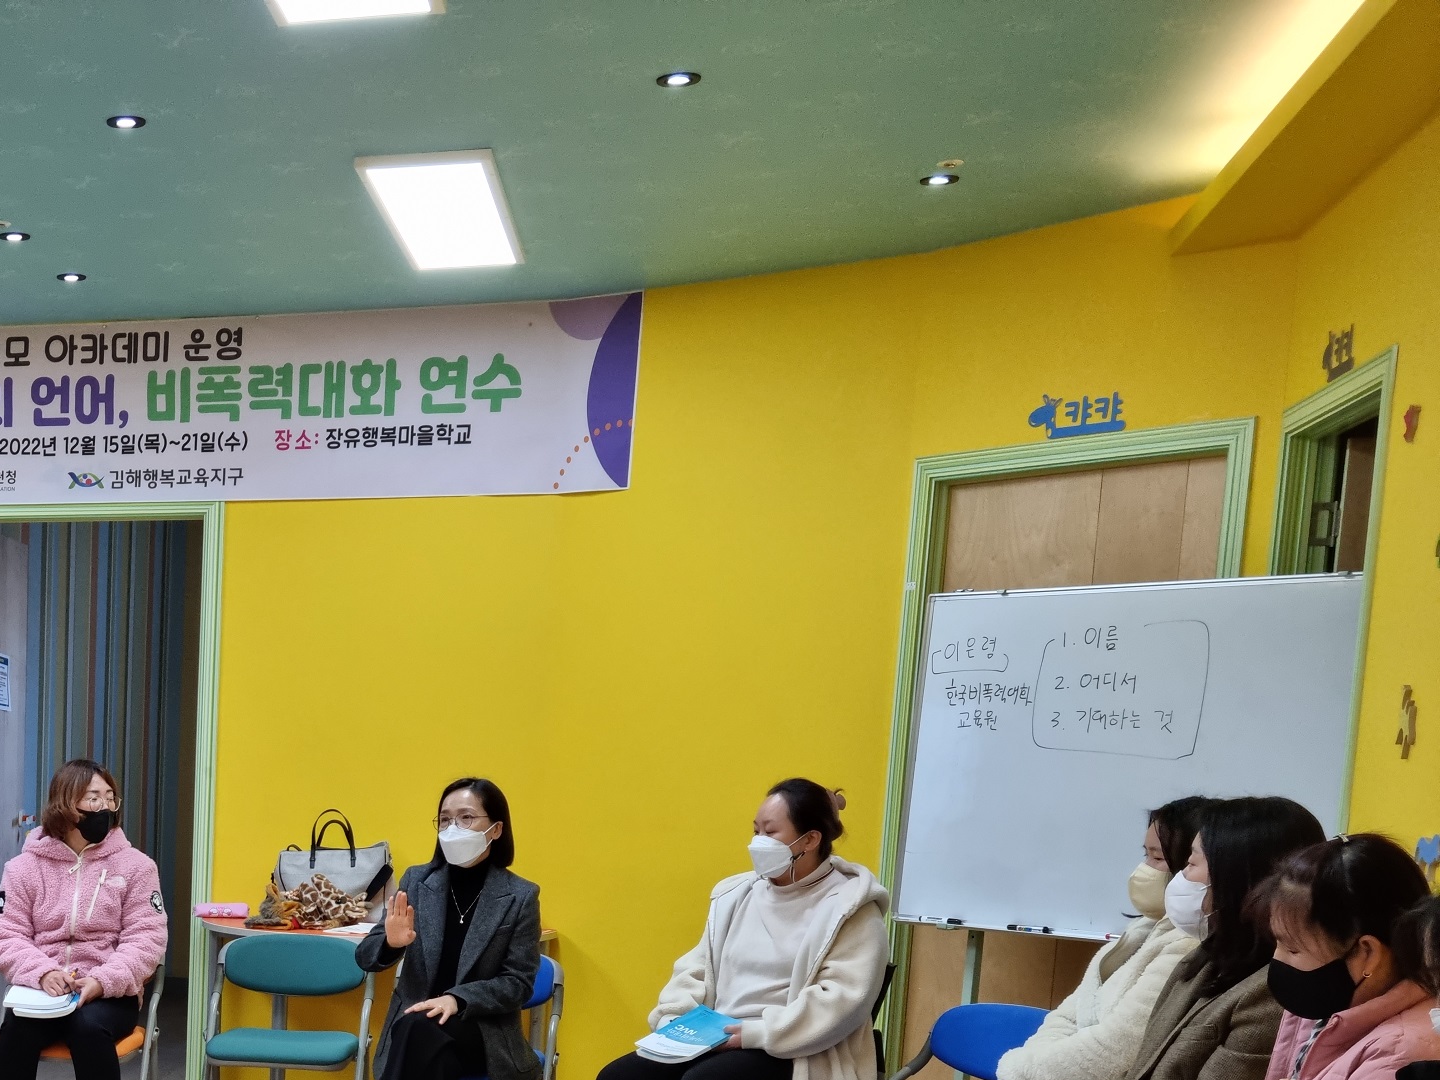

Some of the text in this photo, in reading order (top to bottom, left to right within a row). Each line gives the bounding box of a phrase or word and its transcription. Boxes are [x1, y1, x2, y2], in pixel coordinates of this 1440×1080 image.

[44, 328, 170, 365] 아카데미
[183, 327, 244, 360] 운영
[30, 372, 129, 429] 언어,
[146, 357, 401, 424] 비폭력대화
[419, 352, 522, 413] 연수
[1065, 391, 1123, 425] 캬캬
[64, 434, 96, 455] 12월
[102, 430, 249, 455] 15일(목)~21일(수)
[324, 422, 472, 450] 장유행복마을학교
[108, 467, 244, 490] 김해행복교육지구
[943, 635, 998, 662] 이은령
[1061, 625, 1119, 651] 1. 이름
[1054, 670, 1137, 694] 2. 어디서
[956, 710, 998, 731] 교육원
[1050, 708, 1173, 734] 3. 기대하는 것
